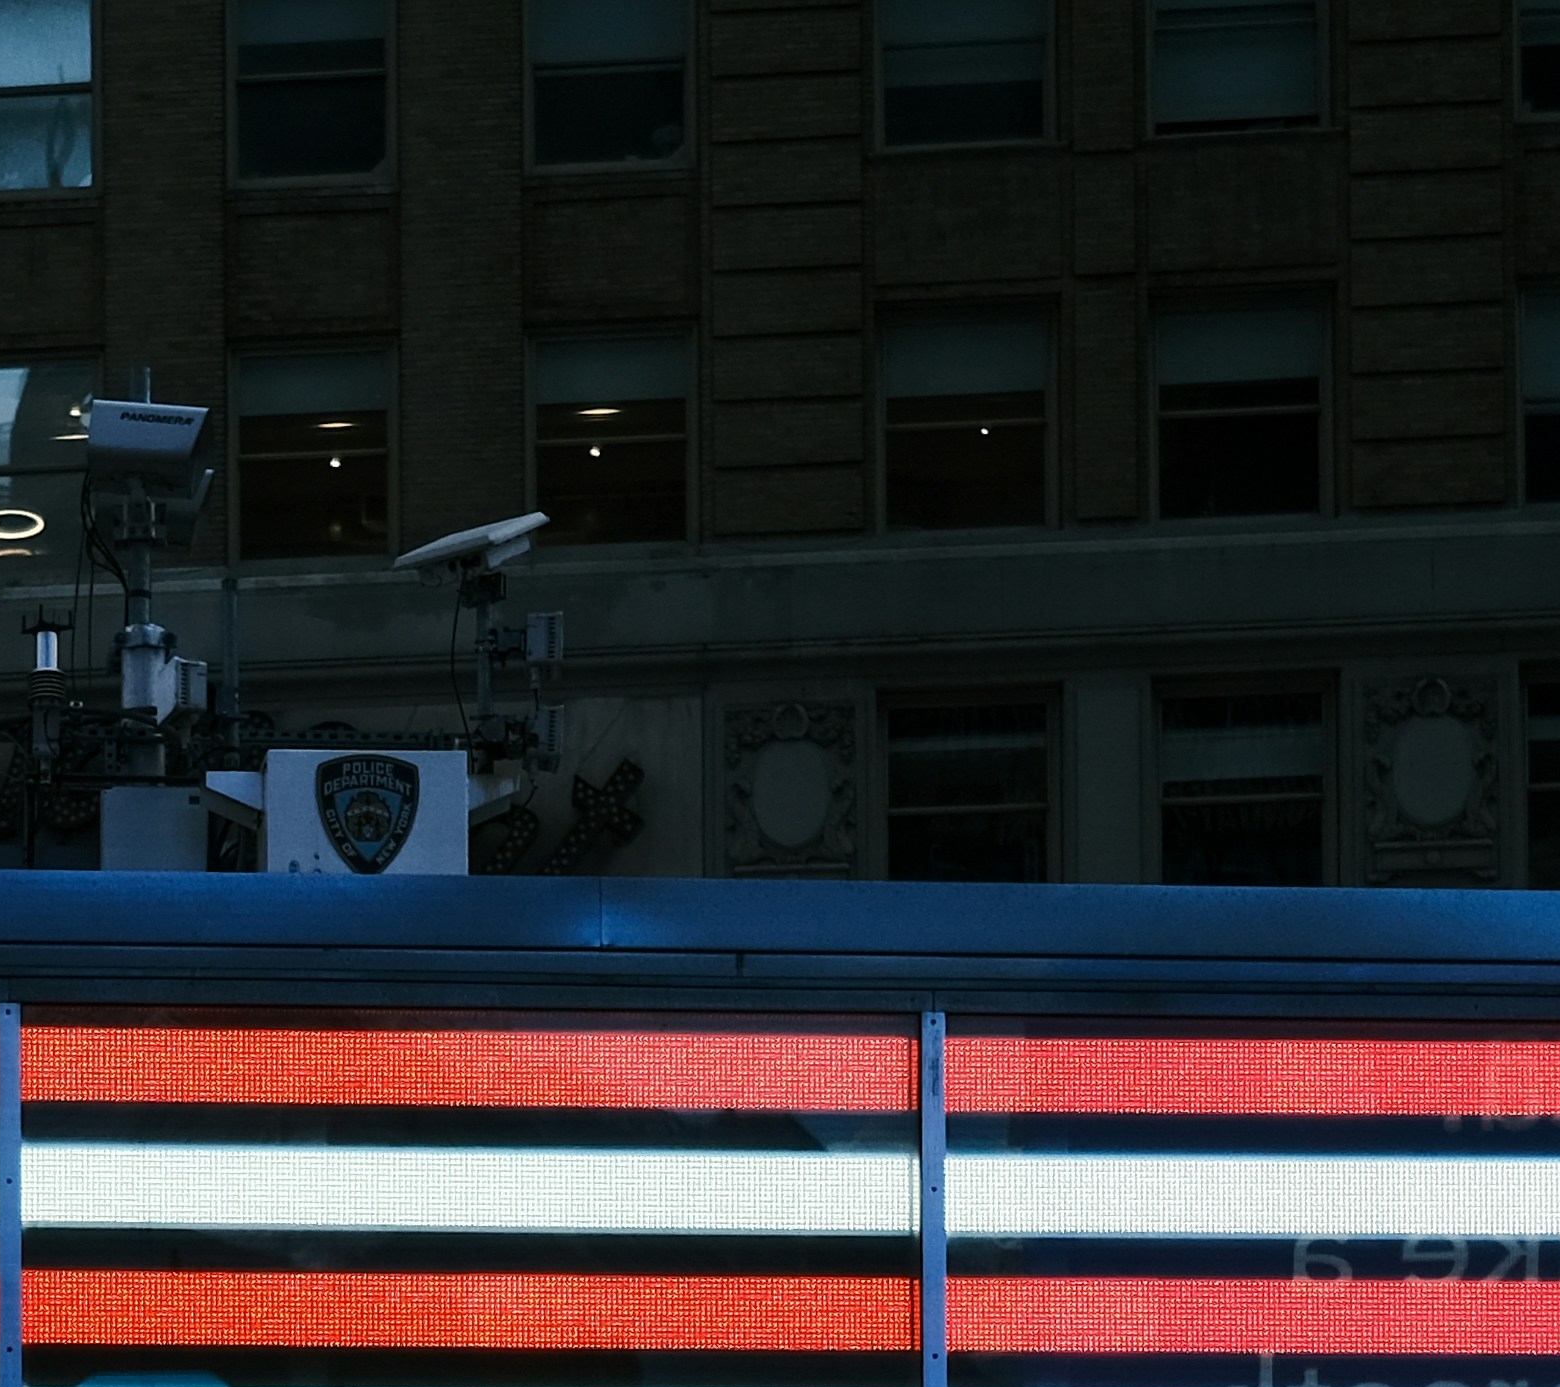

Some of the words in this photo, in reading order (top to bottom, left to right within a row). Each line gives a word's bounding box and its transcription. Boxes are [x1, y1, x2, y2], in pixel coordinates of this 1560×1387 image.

[324, 773, 412, 797] DEPARTMENT
[342, 761, 394, 775] POLICE
[325, 809, 344, 839] CITY
[341, 842, 357, 859] OF
[376, 838, 397, 865] NEW
[393, 802, 413, 835] YORK
